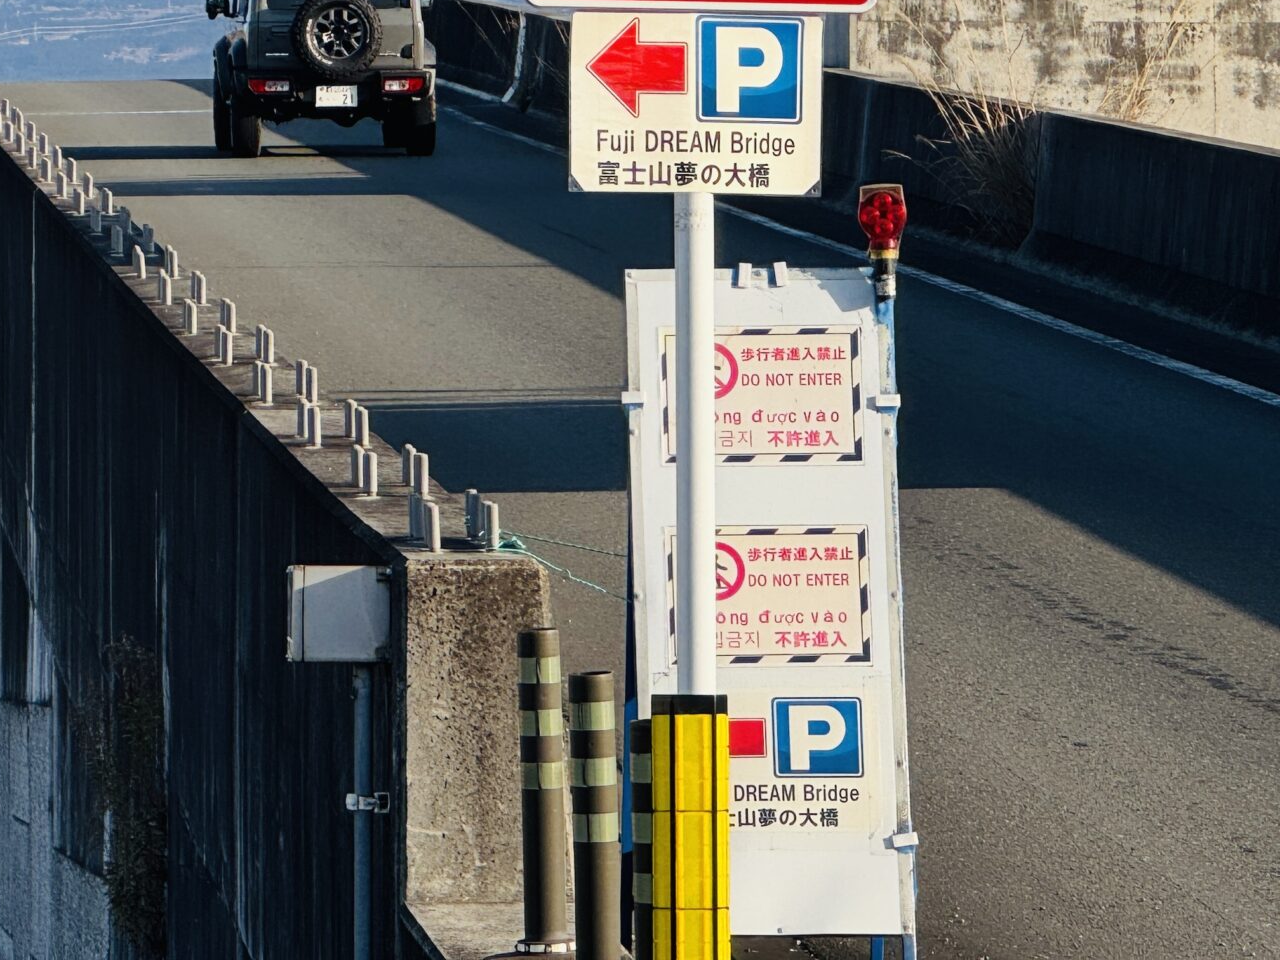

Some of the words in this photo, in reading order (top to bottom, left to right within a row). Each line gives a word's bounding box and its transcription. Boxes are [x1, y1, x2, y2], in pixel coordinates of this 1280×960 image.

[716, 26, 784, 113] P
[596, 129, 635, 154] Fuji
[645, 130, 721, 153] DREAM
[730, 131, 796, 156] Bridge
[597, 161, 770, 188] 富士山夢の大橋
[740, 346, 847, 362] 歩行者進入禁止
[741, 373, 760, 386] DO
[765, 373, 794, 386] NOT
[799, 372, 842, 386] ENTER
[715, 411, 742, 425] ng
[767, 429, 839, 447] 不許進入
[747, 546, 854, 562] 歩行者進入禁止
[748, 574, 767, 587] DO
[772, 573, 801, 587] NOT
[806, 573, 849, 586] ENTER
[775, 630, 847, 648] 不許進入
[788, 705, 847, 770] P
[734, 785, 795, 801] DREAM
[803, 784, 860, 803] Bridge
